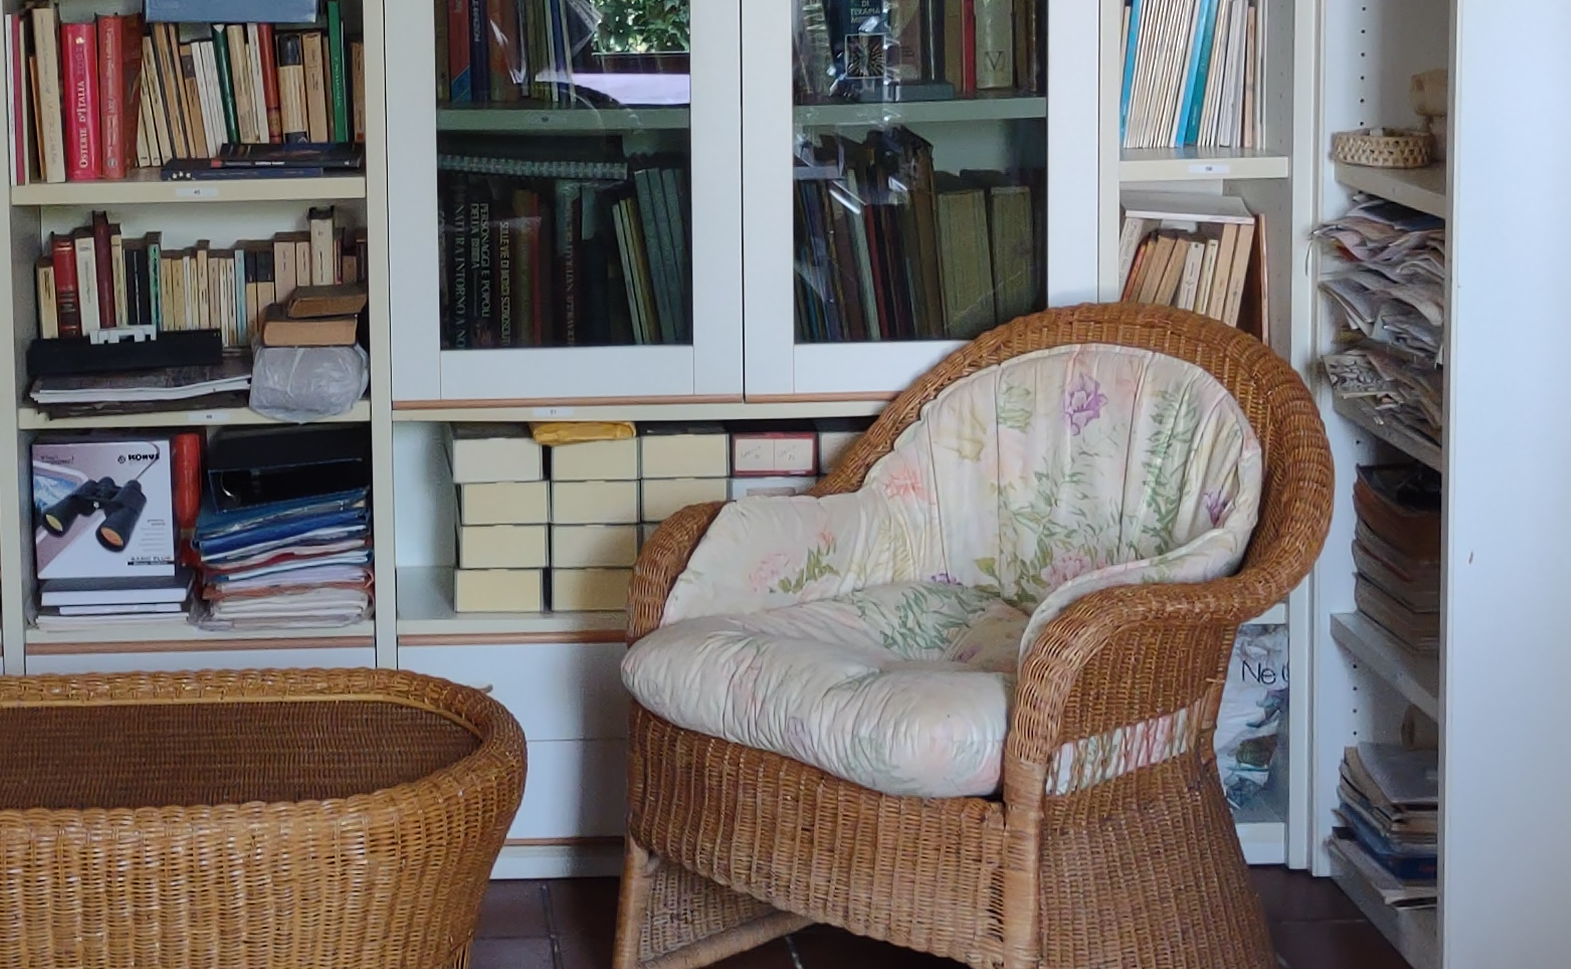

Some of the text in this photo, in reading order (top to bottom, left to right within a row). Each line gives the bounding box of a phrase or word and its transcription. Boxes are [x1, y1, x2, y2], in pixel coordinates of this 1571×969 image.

[76, 81, 86, 123] D'ITALIA
[79, 127, 89, 168] OSTERIE
[454, 204, 465, 254] NATURA
[480, 203, 490, 268] PERSONAGGI
[454, 257, 466, 314] INTORNO
[481, 280, 490, 318] POPOLI
[456, 330, 466, 347] NO
[565, 294, 574, 345] ERAVIGLIE
